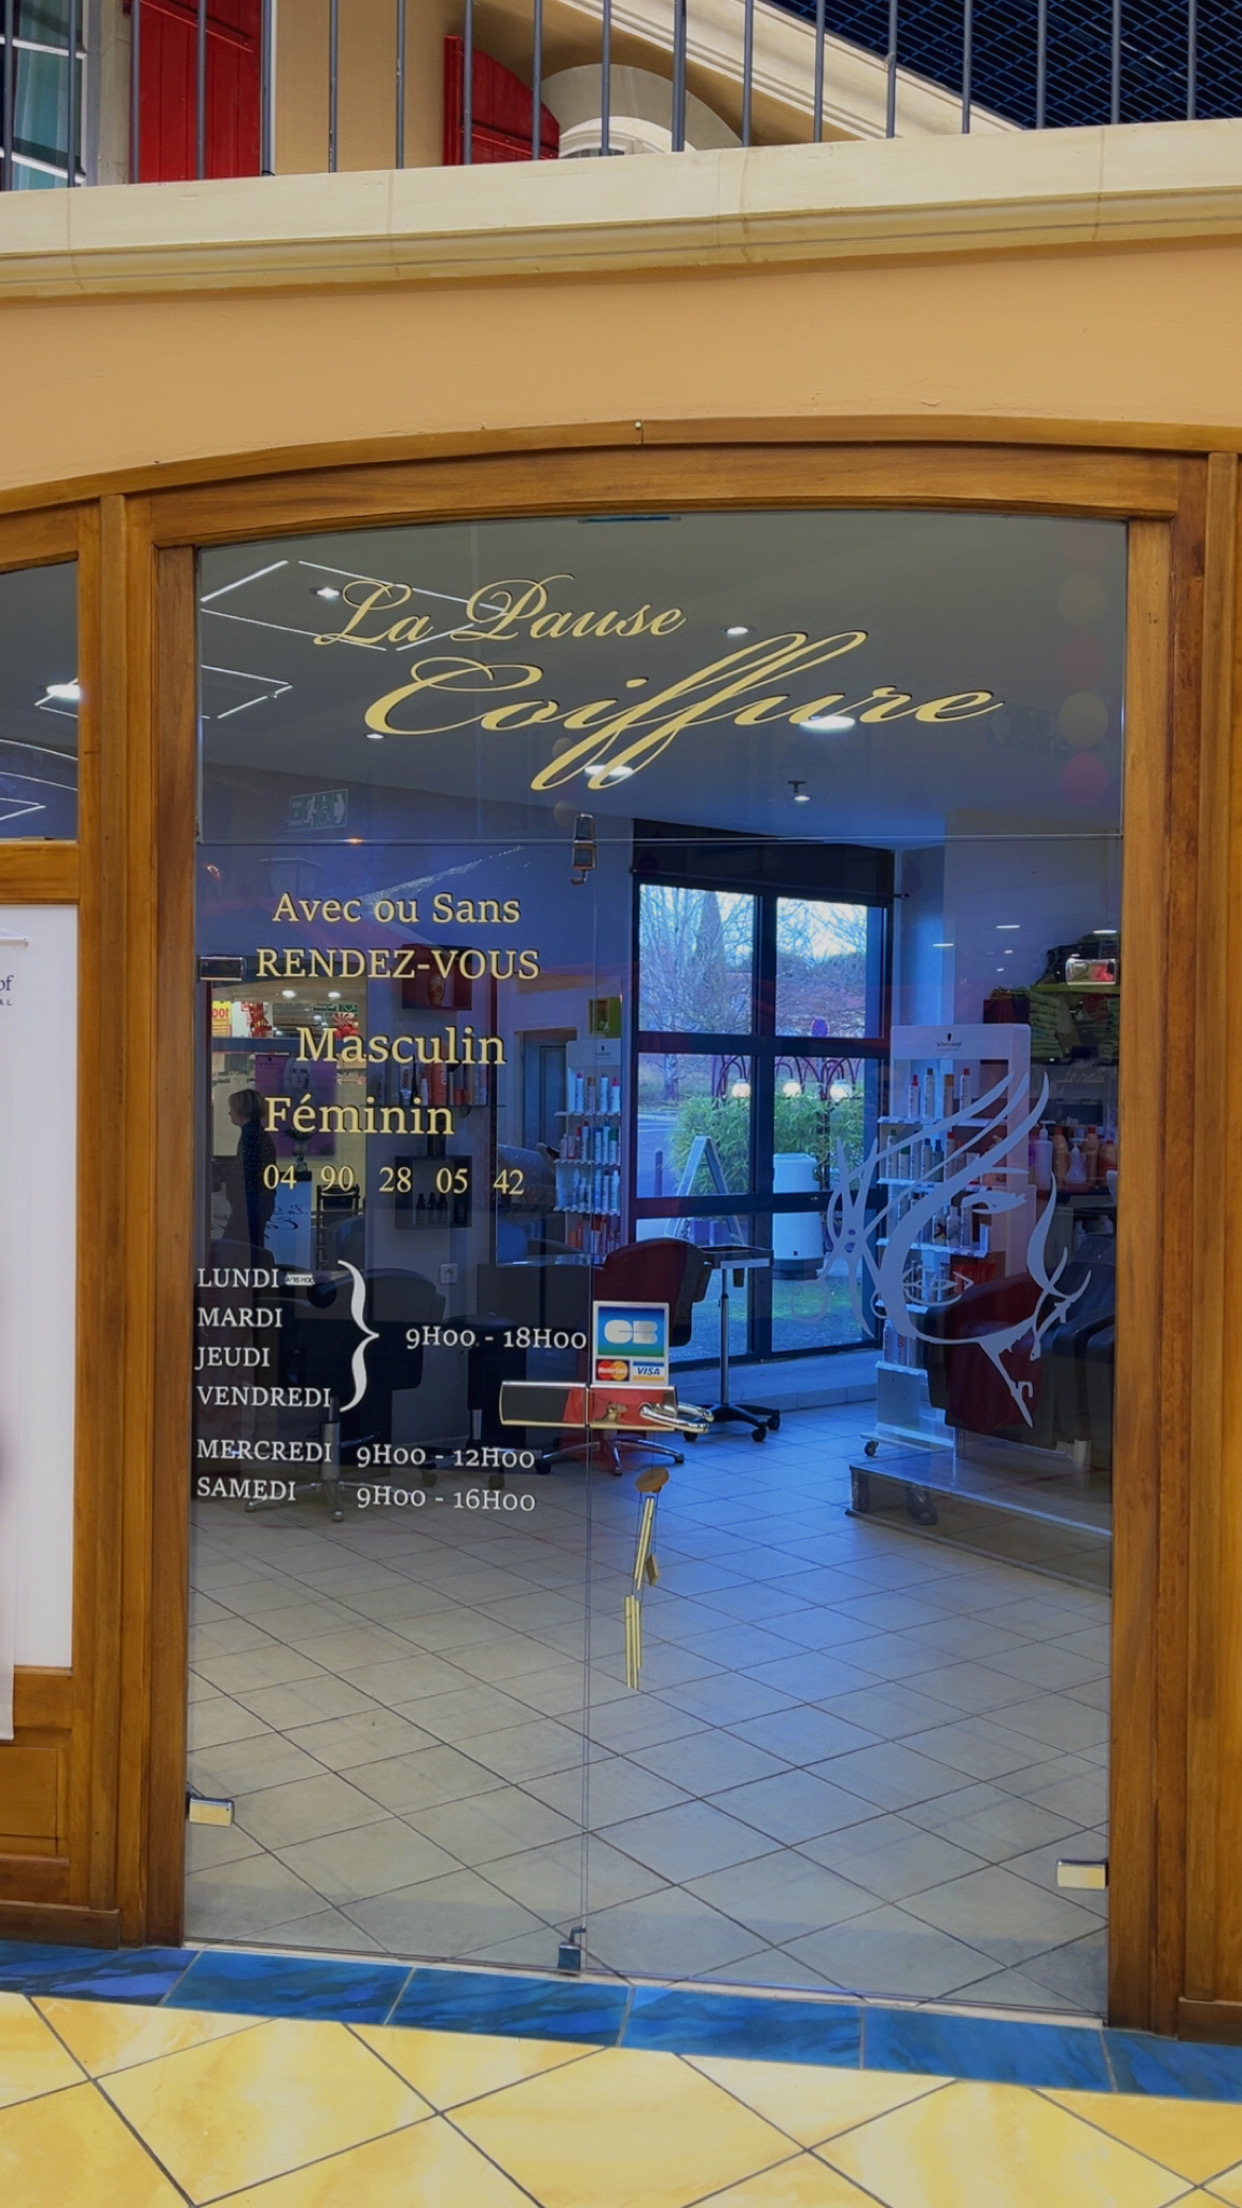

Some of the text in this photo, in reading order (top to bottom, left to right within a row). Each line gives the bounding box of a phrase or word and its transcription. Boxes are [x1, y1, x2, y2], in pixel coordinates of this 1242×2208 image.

[314, 574, 686, 646] La Pause
[363, 630, 1004, 791] Coiffure
[272, 892, 521, 924] Avec ou Sans
[256, 948, 540, 980] RENDEZ-VOUS
[296, 1026, 505, 1065] Masculin
[264, 1093, 455, 1135] Féminin
[263, 1164, 523, 1195] 04 90 28 05 42
[197, 1268, 279, 1288] LUNDI
[198, 1307, 282, 1327] MARDI
[194, 1347, 270, 1370] JEUDI
[637, 1367, 660, 1376] VISA
[197, 1386, 331, 1407] VENDREDI
[197, 1439, 332, 1462] MERCREDI
[197, 1477, 296, 1501] SAMEDI
